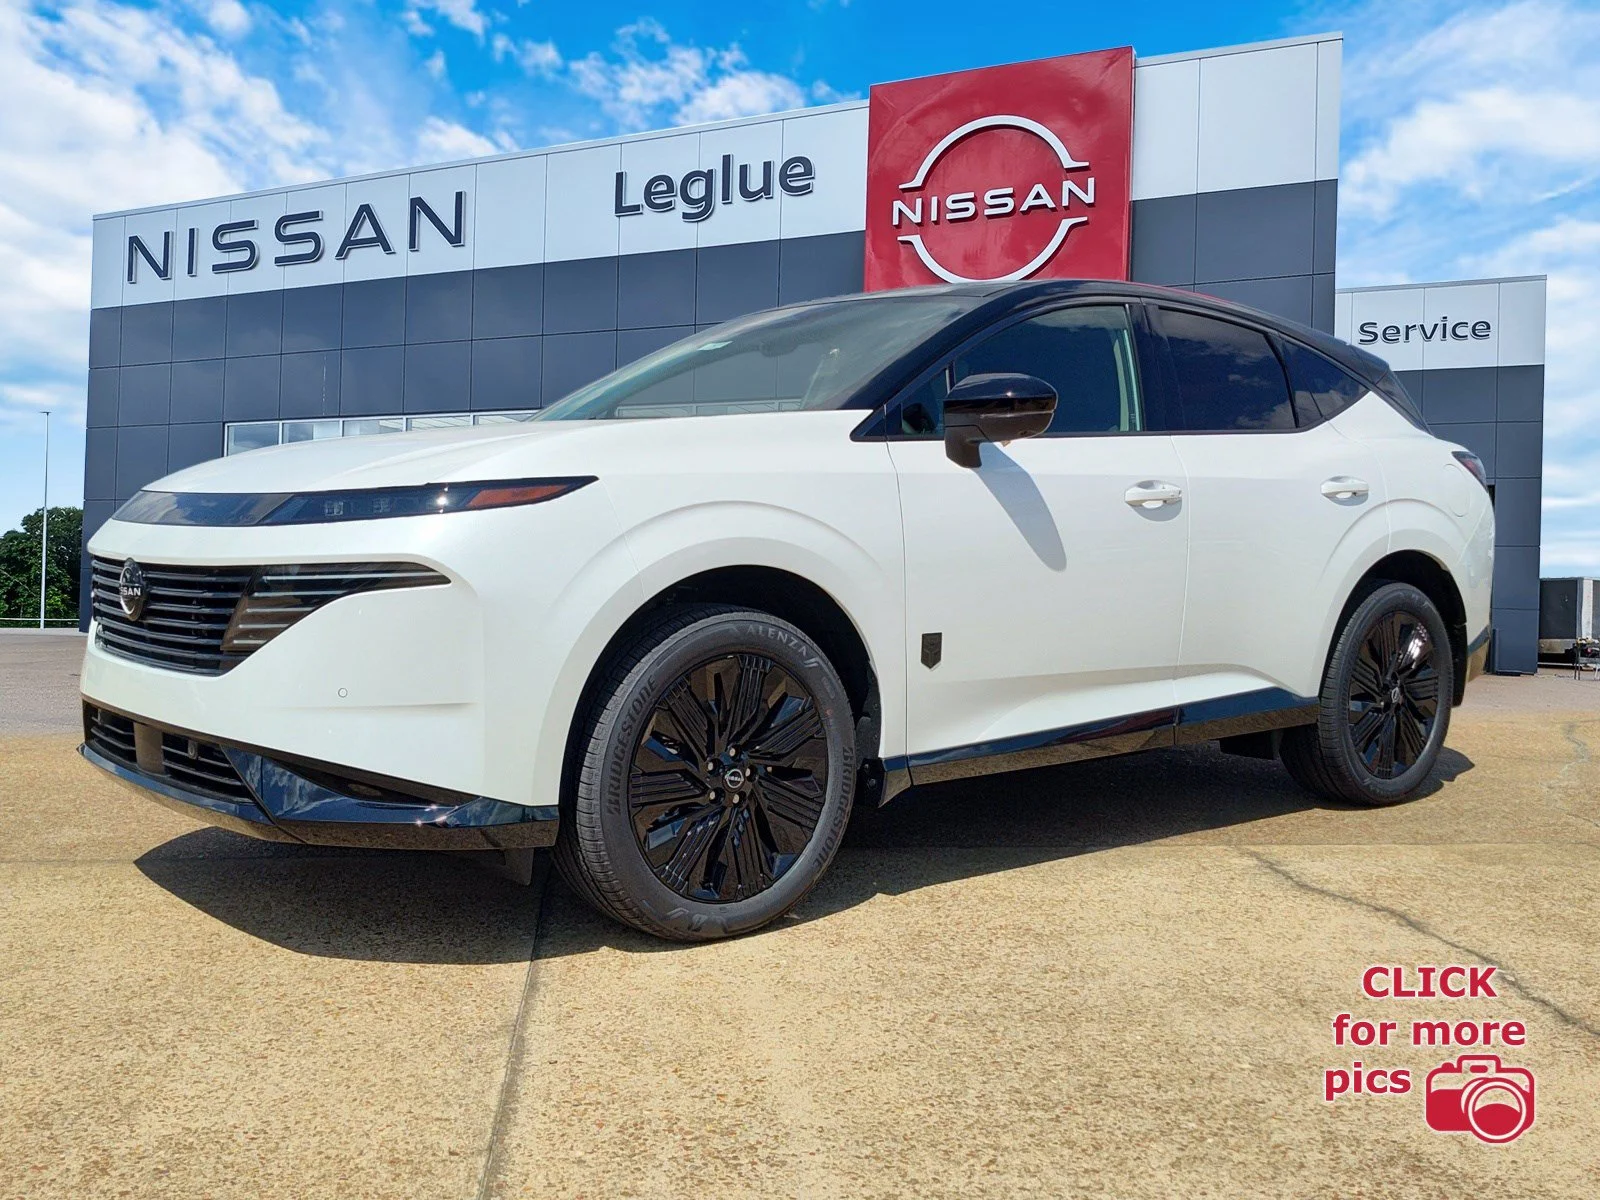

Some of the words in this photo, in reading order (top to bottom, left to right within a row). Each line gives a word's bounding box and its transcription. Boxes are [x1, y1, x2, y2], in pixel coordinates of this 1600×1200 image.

[614, 153, 815, 223] Leglue
[892, 177, 1096, 226] NISSAN
[127, 190, 466, 284] NISSAN
[1358, 315, 1492, 346] Service
[747, 624, 808, 656] ALENZA
[606, 674, 658, 816] BRIDGESTONE
